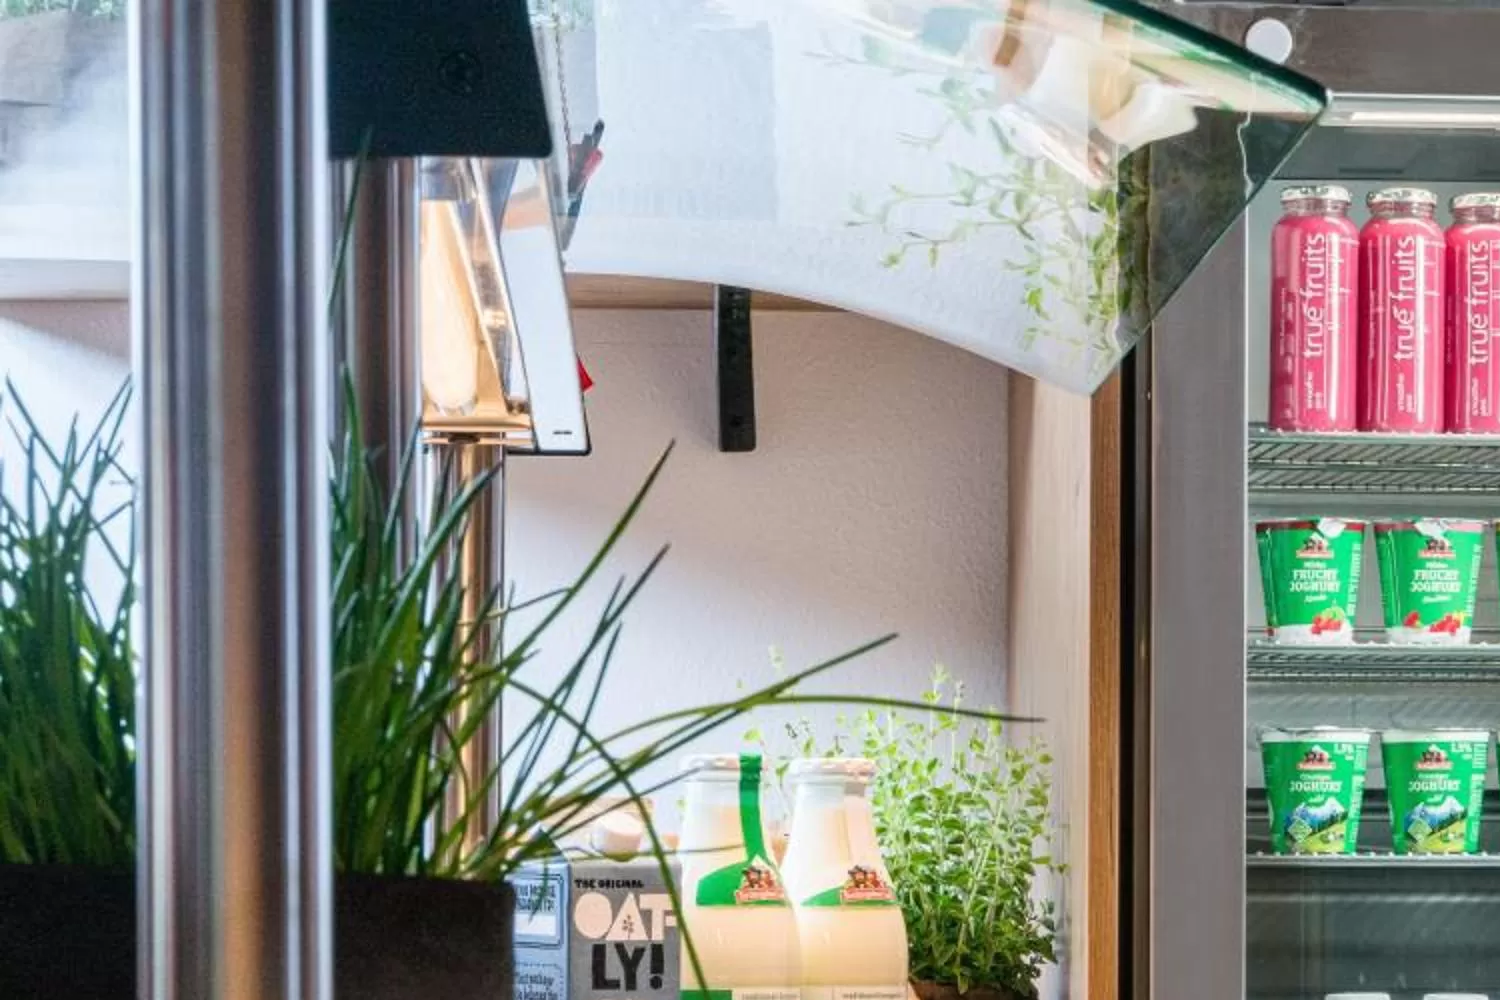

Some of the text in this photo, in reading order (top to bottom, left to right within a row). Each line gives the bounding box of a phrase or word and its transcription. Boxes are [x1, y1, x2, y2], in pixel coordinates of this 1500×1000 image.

[1300, 232, 1324, 358] true fruits
[1389, 235, 1415, 361] true fruits
[1467, 240, 1489, 365] true fruits
[575, 879, 644, 889] THE ORIGINAL
[592, 943, 664, 992] LY!
